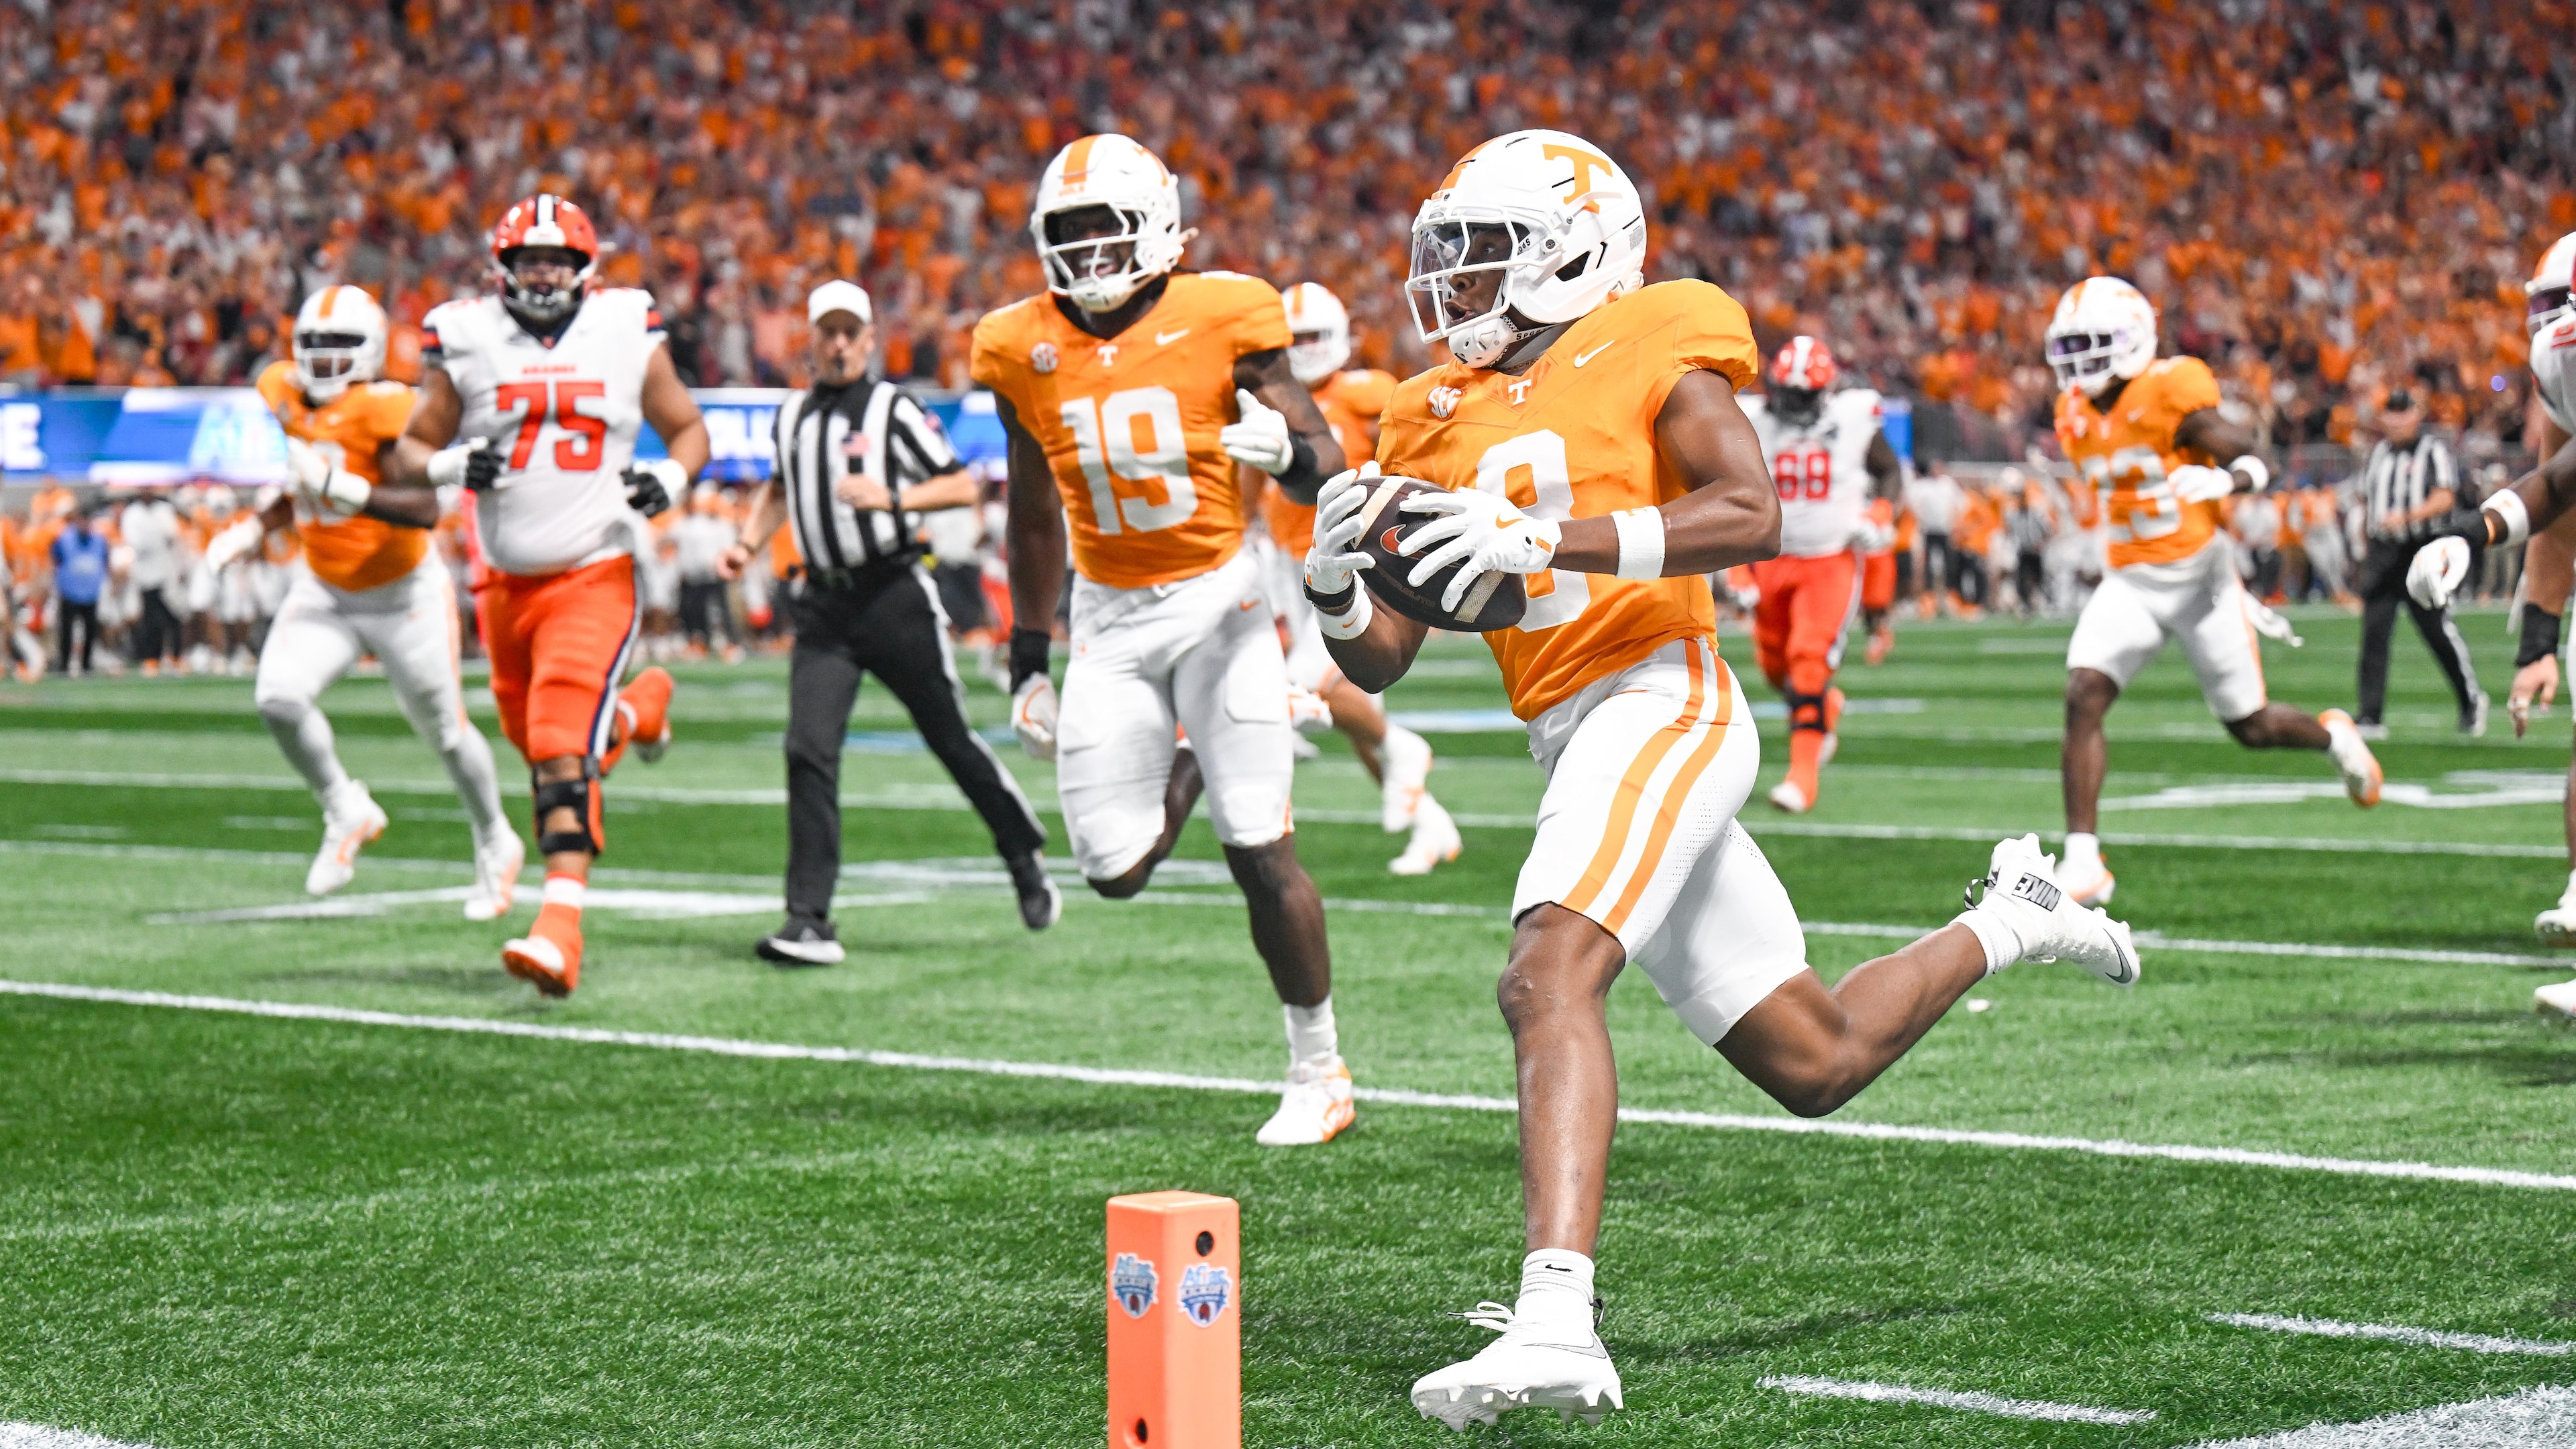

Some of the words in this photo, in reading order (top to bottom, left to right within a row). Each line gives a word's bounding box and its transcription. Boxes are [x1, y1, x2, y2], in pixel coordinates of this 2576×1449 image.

[1542, 144, 1613, 215] T
[1097, 345, 1119, 367] T
[1428, 386, 1463, 419] SEC
[1507, 378, 1532, 407] T
[496, 380, 608, 472] 75
[1060, 384, 1199, 535] 19
[1774, 449, 1832, 503] 68
[2011, 871, 2061, 912] NIKE
